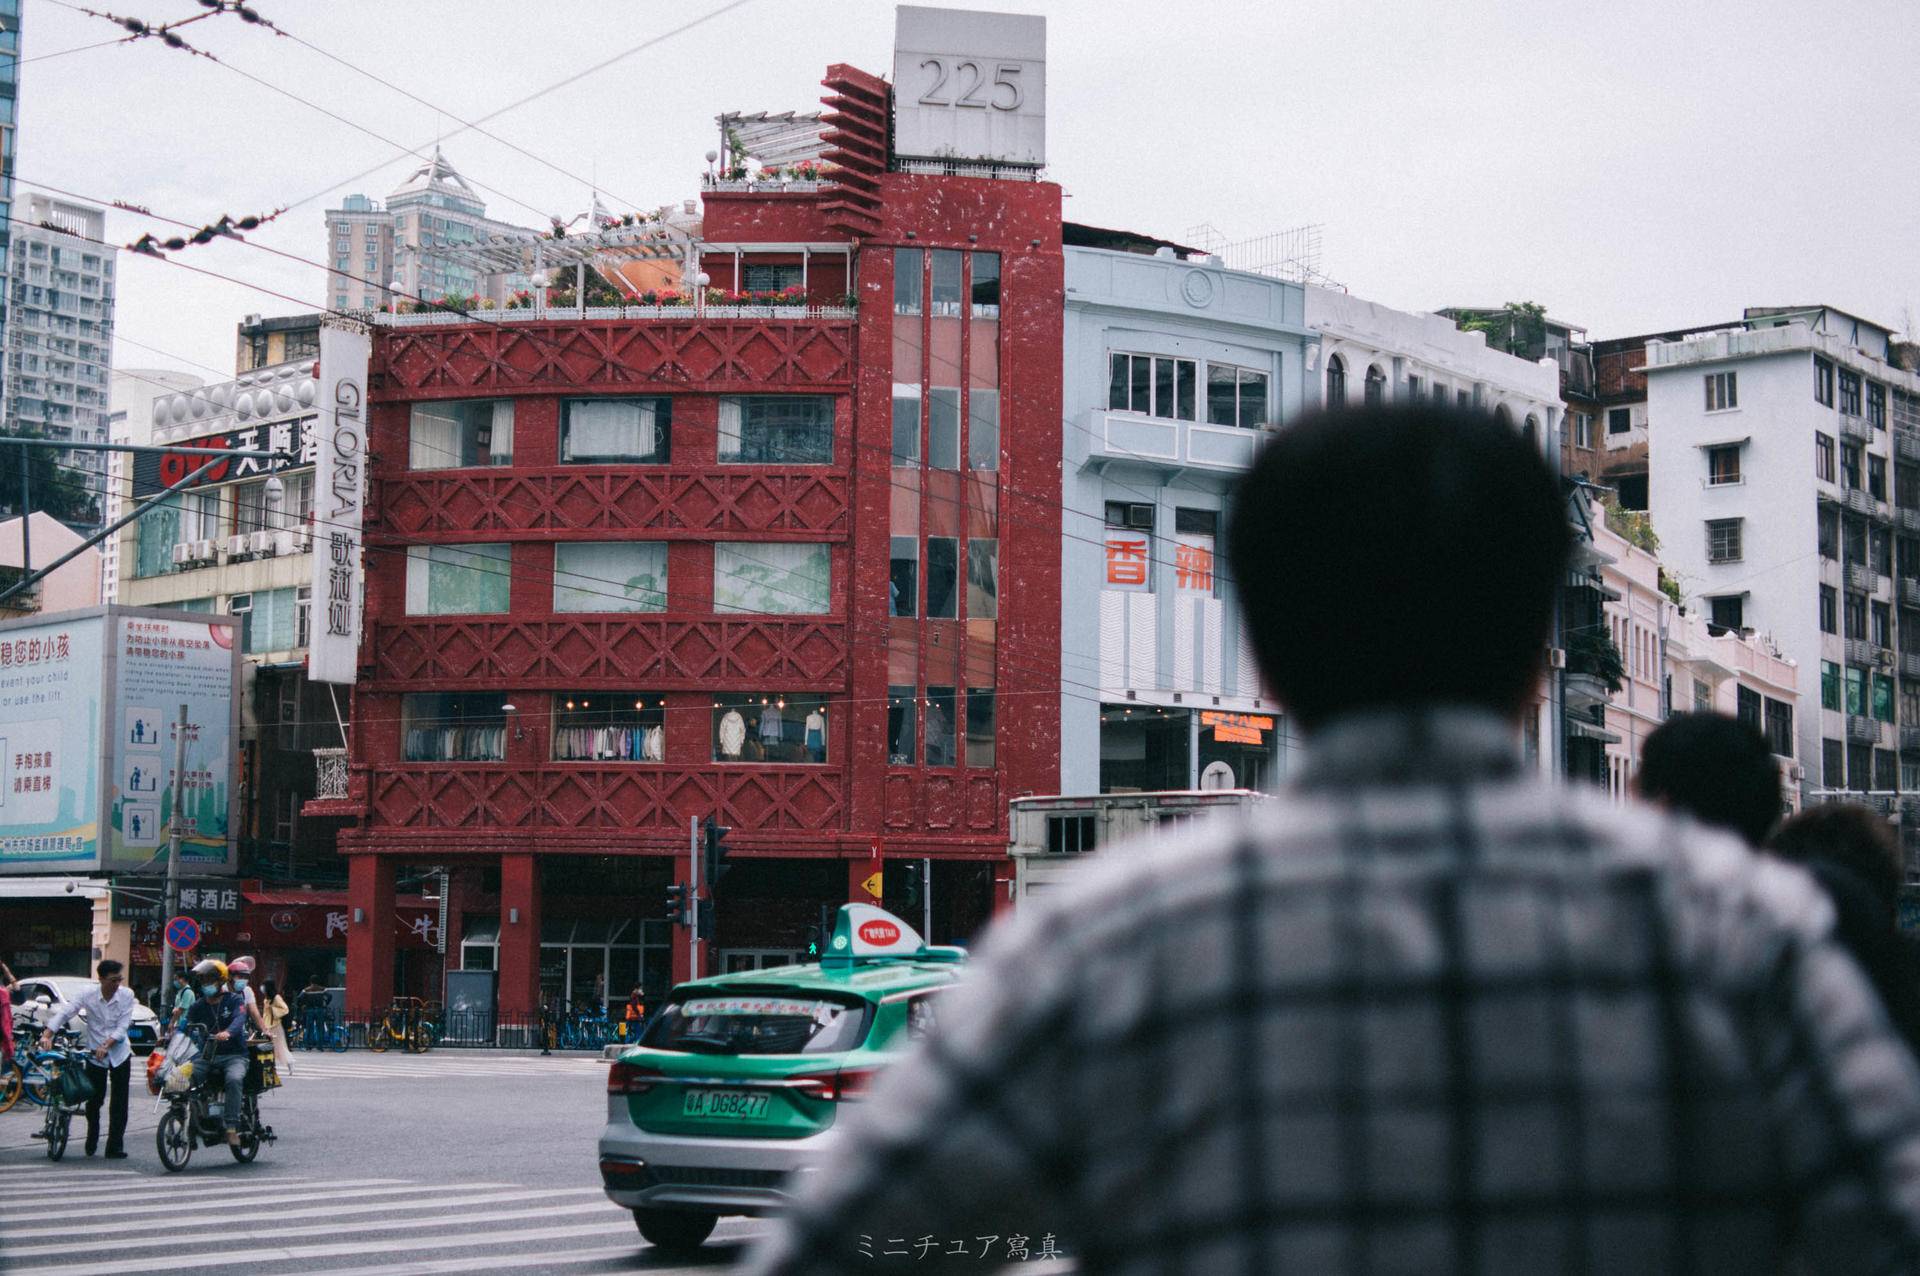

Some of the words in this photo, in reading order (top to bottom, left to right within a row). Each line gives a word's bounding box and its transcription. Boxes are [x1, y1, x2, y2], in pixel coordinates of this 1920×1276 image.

[918, 60, 1024, 111] 225
[332, 377, 359, 518] GLORIA
[327, 531, 353, 636] 歌莉娅
[160, 888, 238, 910] 顺酒店
[710, 1093, 769, 1115] DG8277
